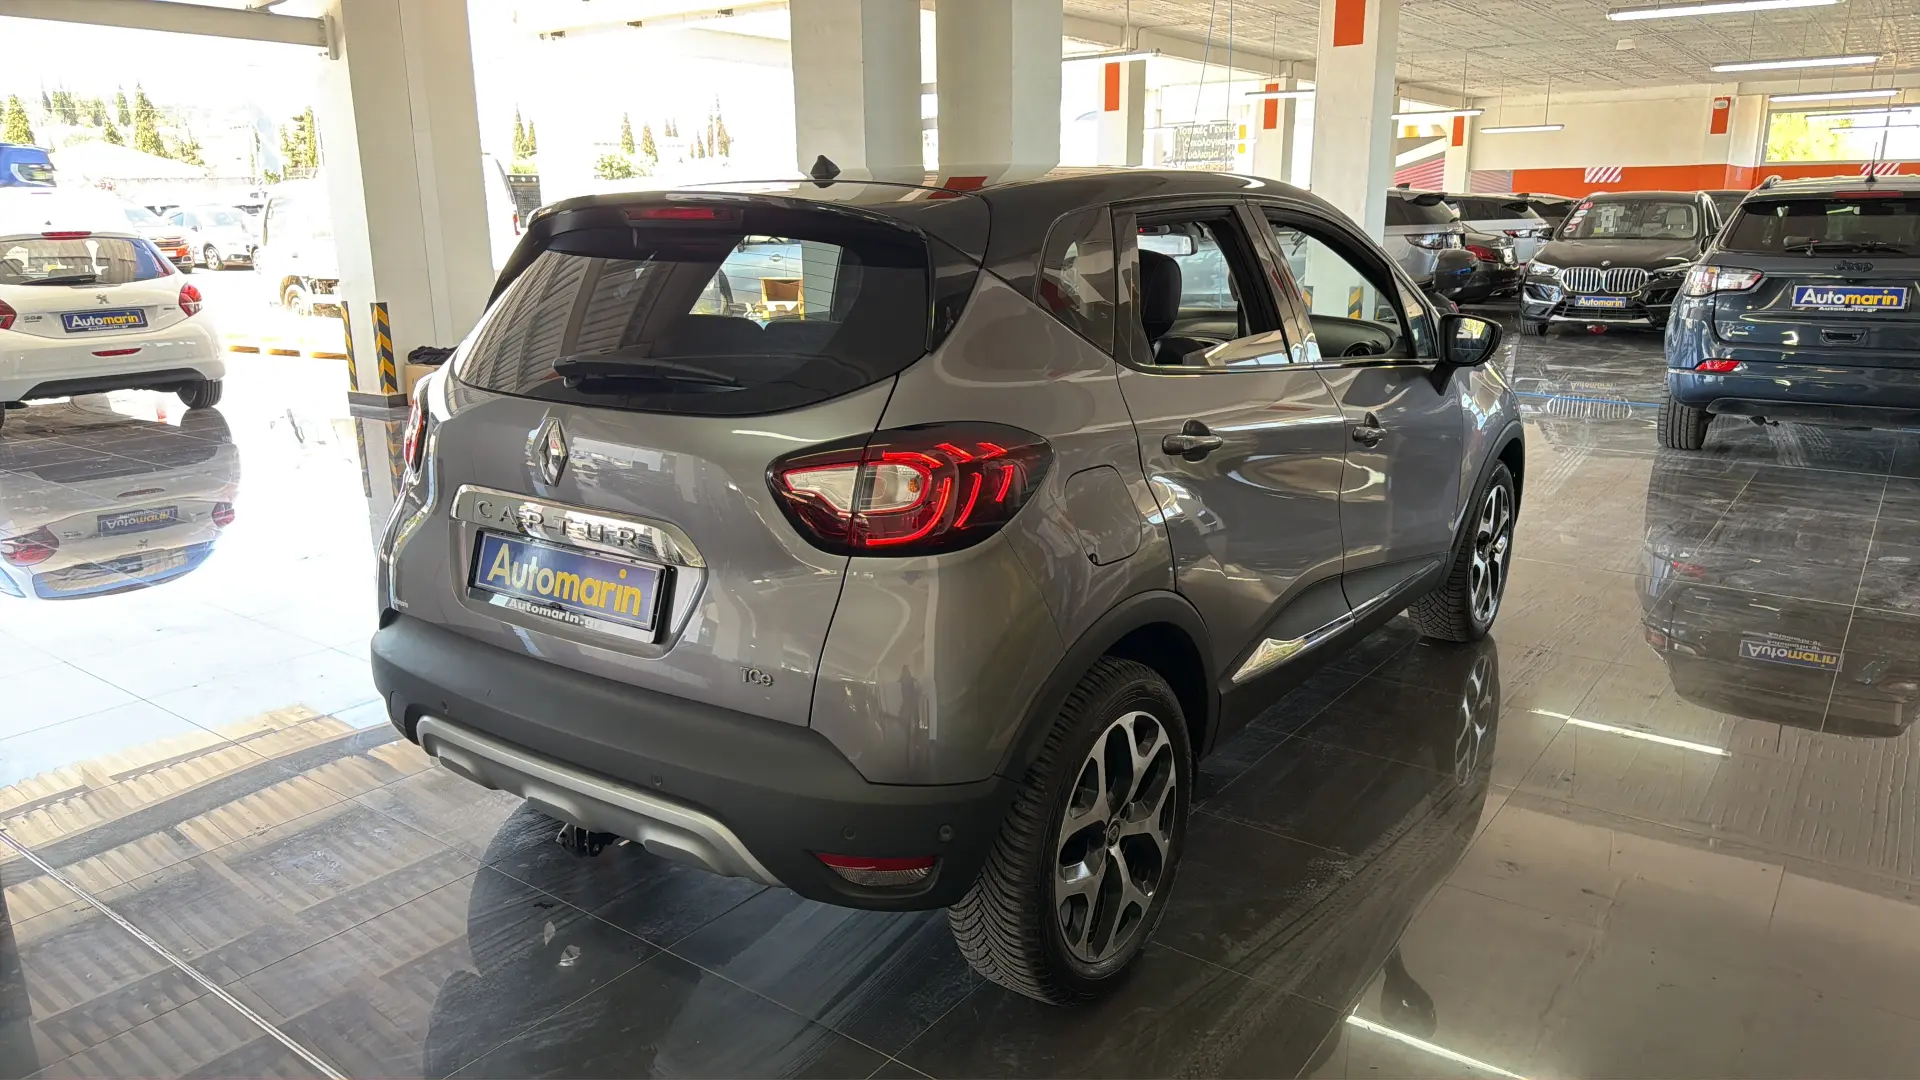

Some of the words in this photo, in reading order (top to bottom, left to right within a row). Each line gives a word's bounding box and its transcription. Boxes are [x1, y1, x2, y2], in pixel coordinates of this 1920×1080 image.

[1834, 260, 1874, 272] Jeep
[1577, 297, 1623, 306] Automarin
[1800, 288, 1898, 306] Automarin
[71, 312, 139, 326] Automarin
[476, 500, 639, 549] CAPTUR
[487, 543, 642, 617] Automarin
[740, 666, 773, 687] TCe
